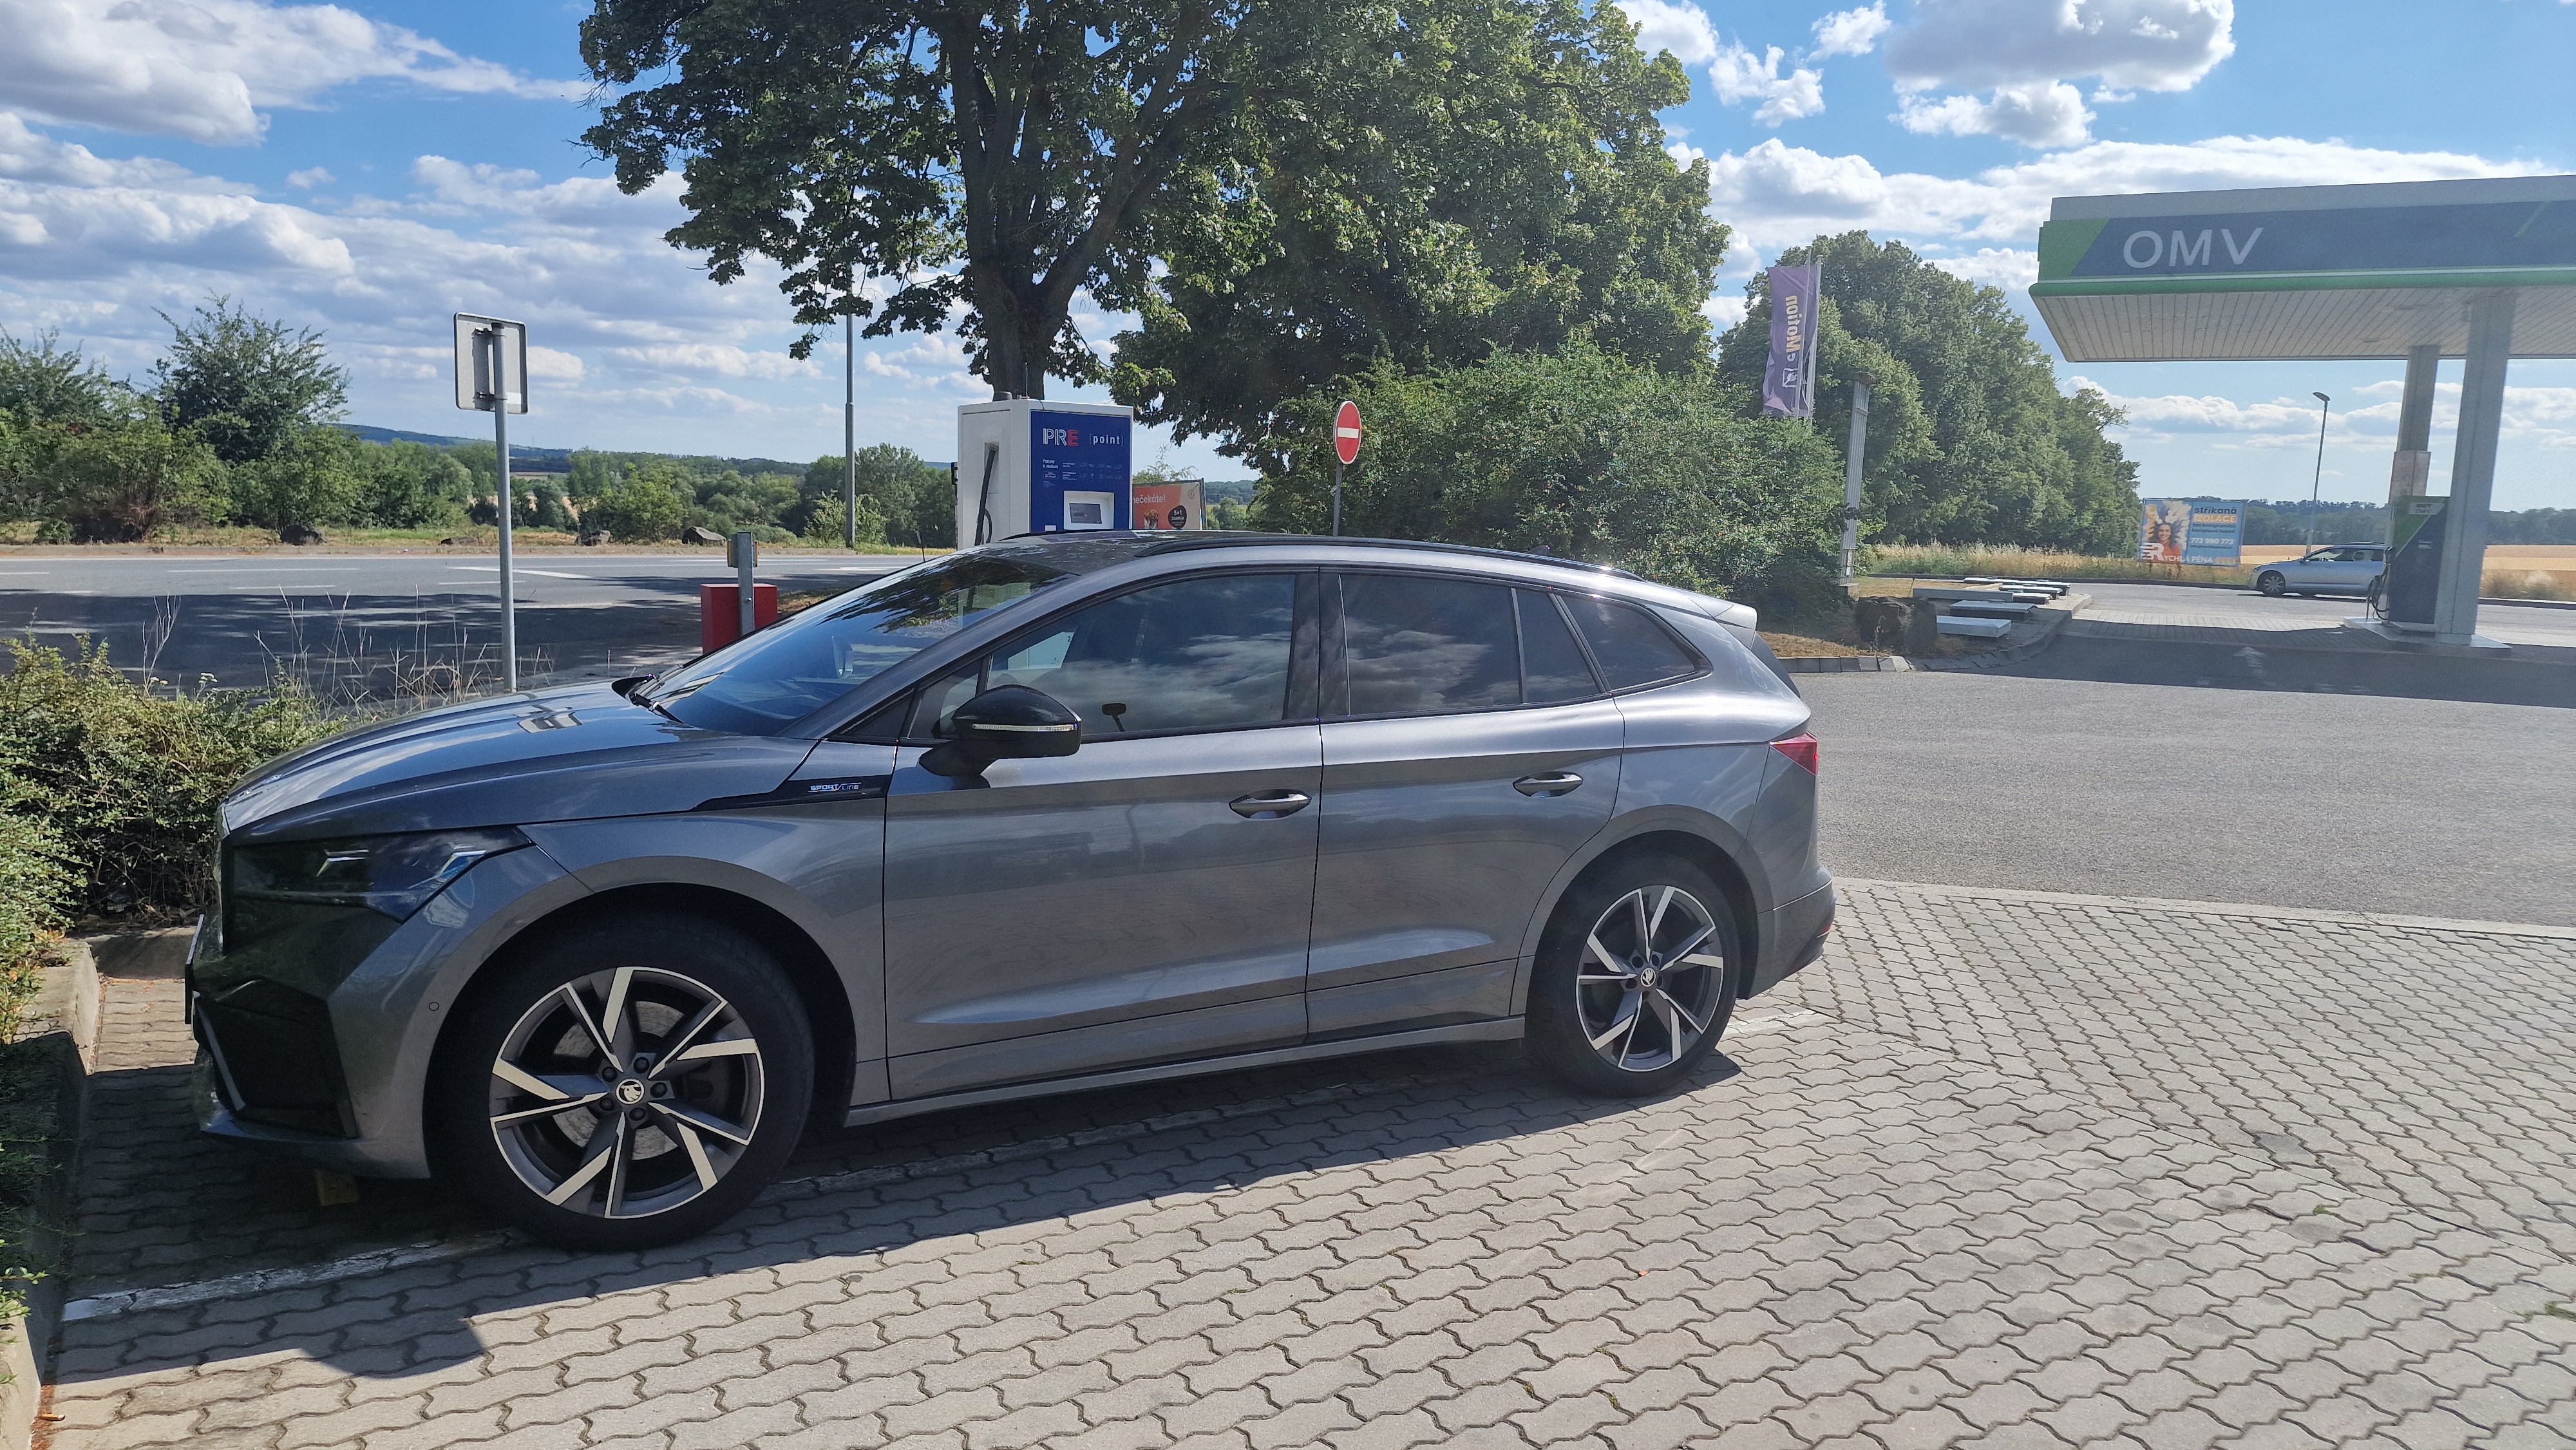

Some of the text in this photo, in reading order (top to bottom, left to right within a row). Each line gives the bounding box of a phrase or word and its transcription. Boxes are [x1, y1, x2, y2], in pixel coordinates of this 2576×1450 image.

[2123, 227, 2264, 268] OMV
[1043, 428, 1079, 447] PRE
[2195, 506, 2237, 514] stříkaná
[2139, 542, 2190, 562] RYCHLÁ
